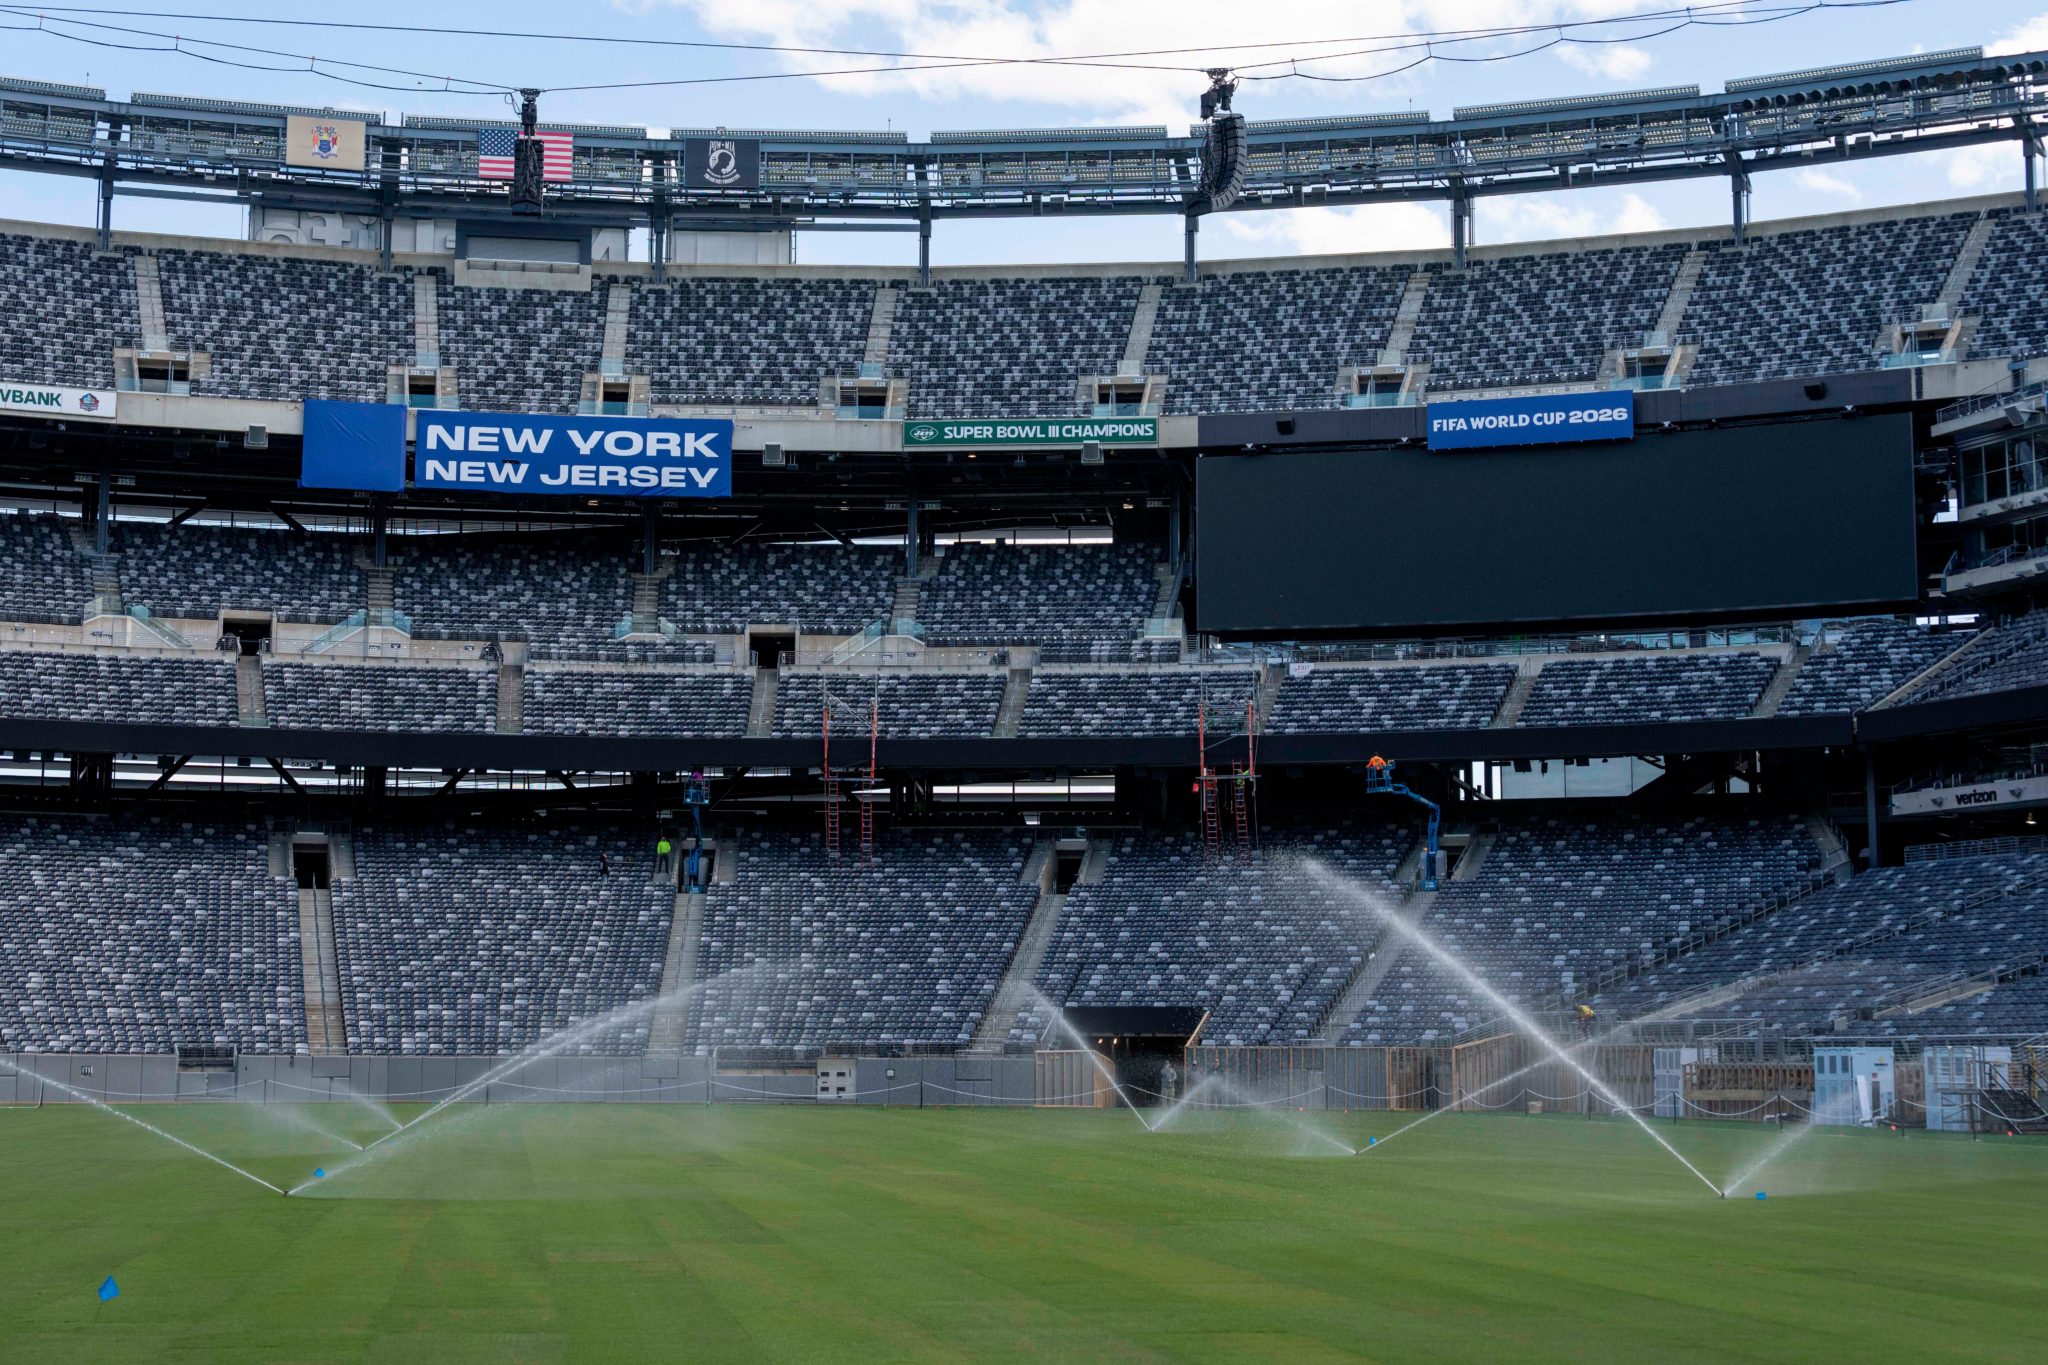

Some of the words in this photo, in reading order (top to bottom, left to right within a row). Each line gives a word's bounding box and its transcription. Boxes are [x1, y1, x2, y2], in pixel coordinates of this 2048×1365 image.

[943, 425, 993, 439] SUPER
[996, 425, 1046, 439] BOWL
[1048, 425, 1060, 438] III
[1061, 423, 1155, 438] CHAMPIONS
[1433, 417, 1468, 432] FIFA
[1470, 413, 1531, 430] WORLD
[1532, 411, 1566, 426] CUP
[1568, 407, 1629, 424] 2026
[426, 424, 554, 454] NEW
[566, 429, 719, 458] YORK
[425, 459, 529, 484] NEW
[539, 465, 719, 488] JERSEY
[1955, 789, 1998, 806] verizon
